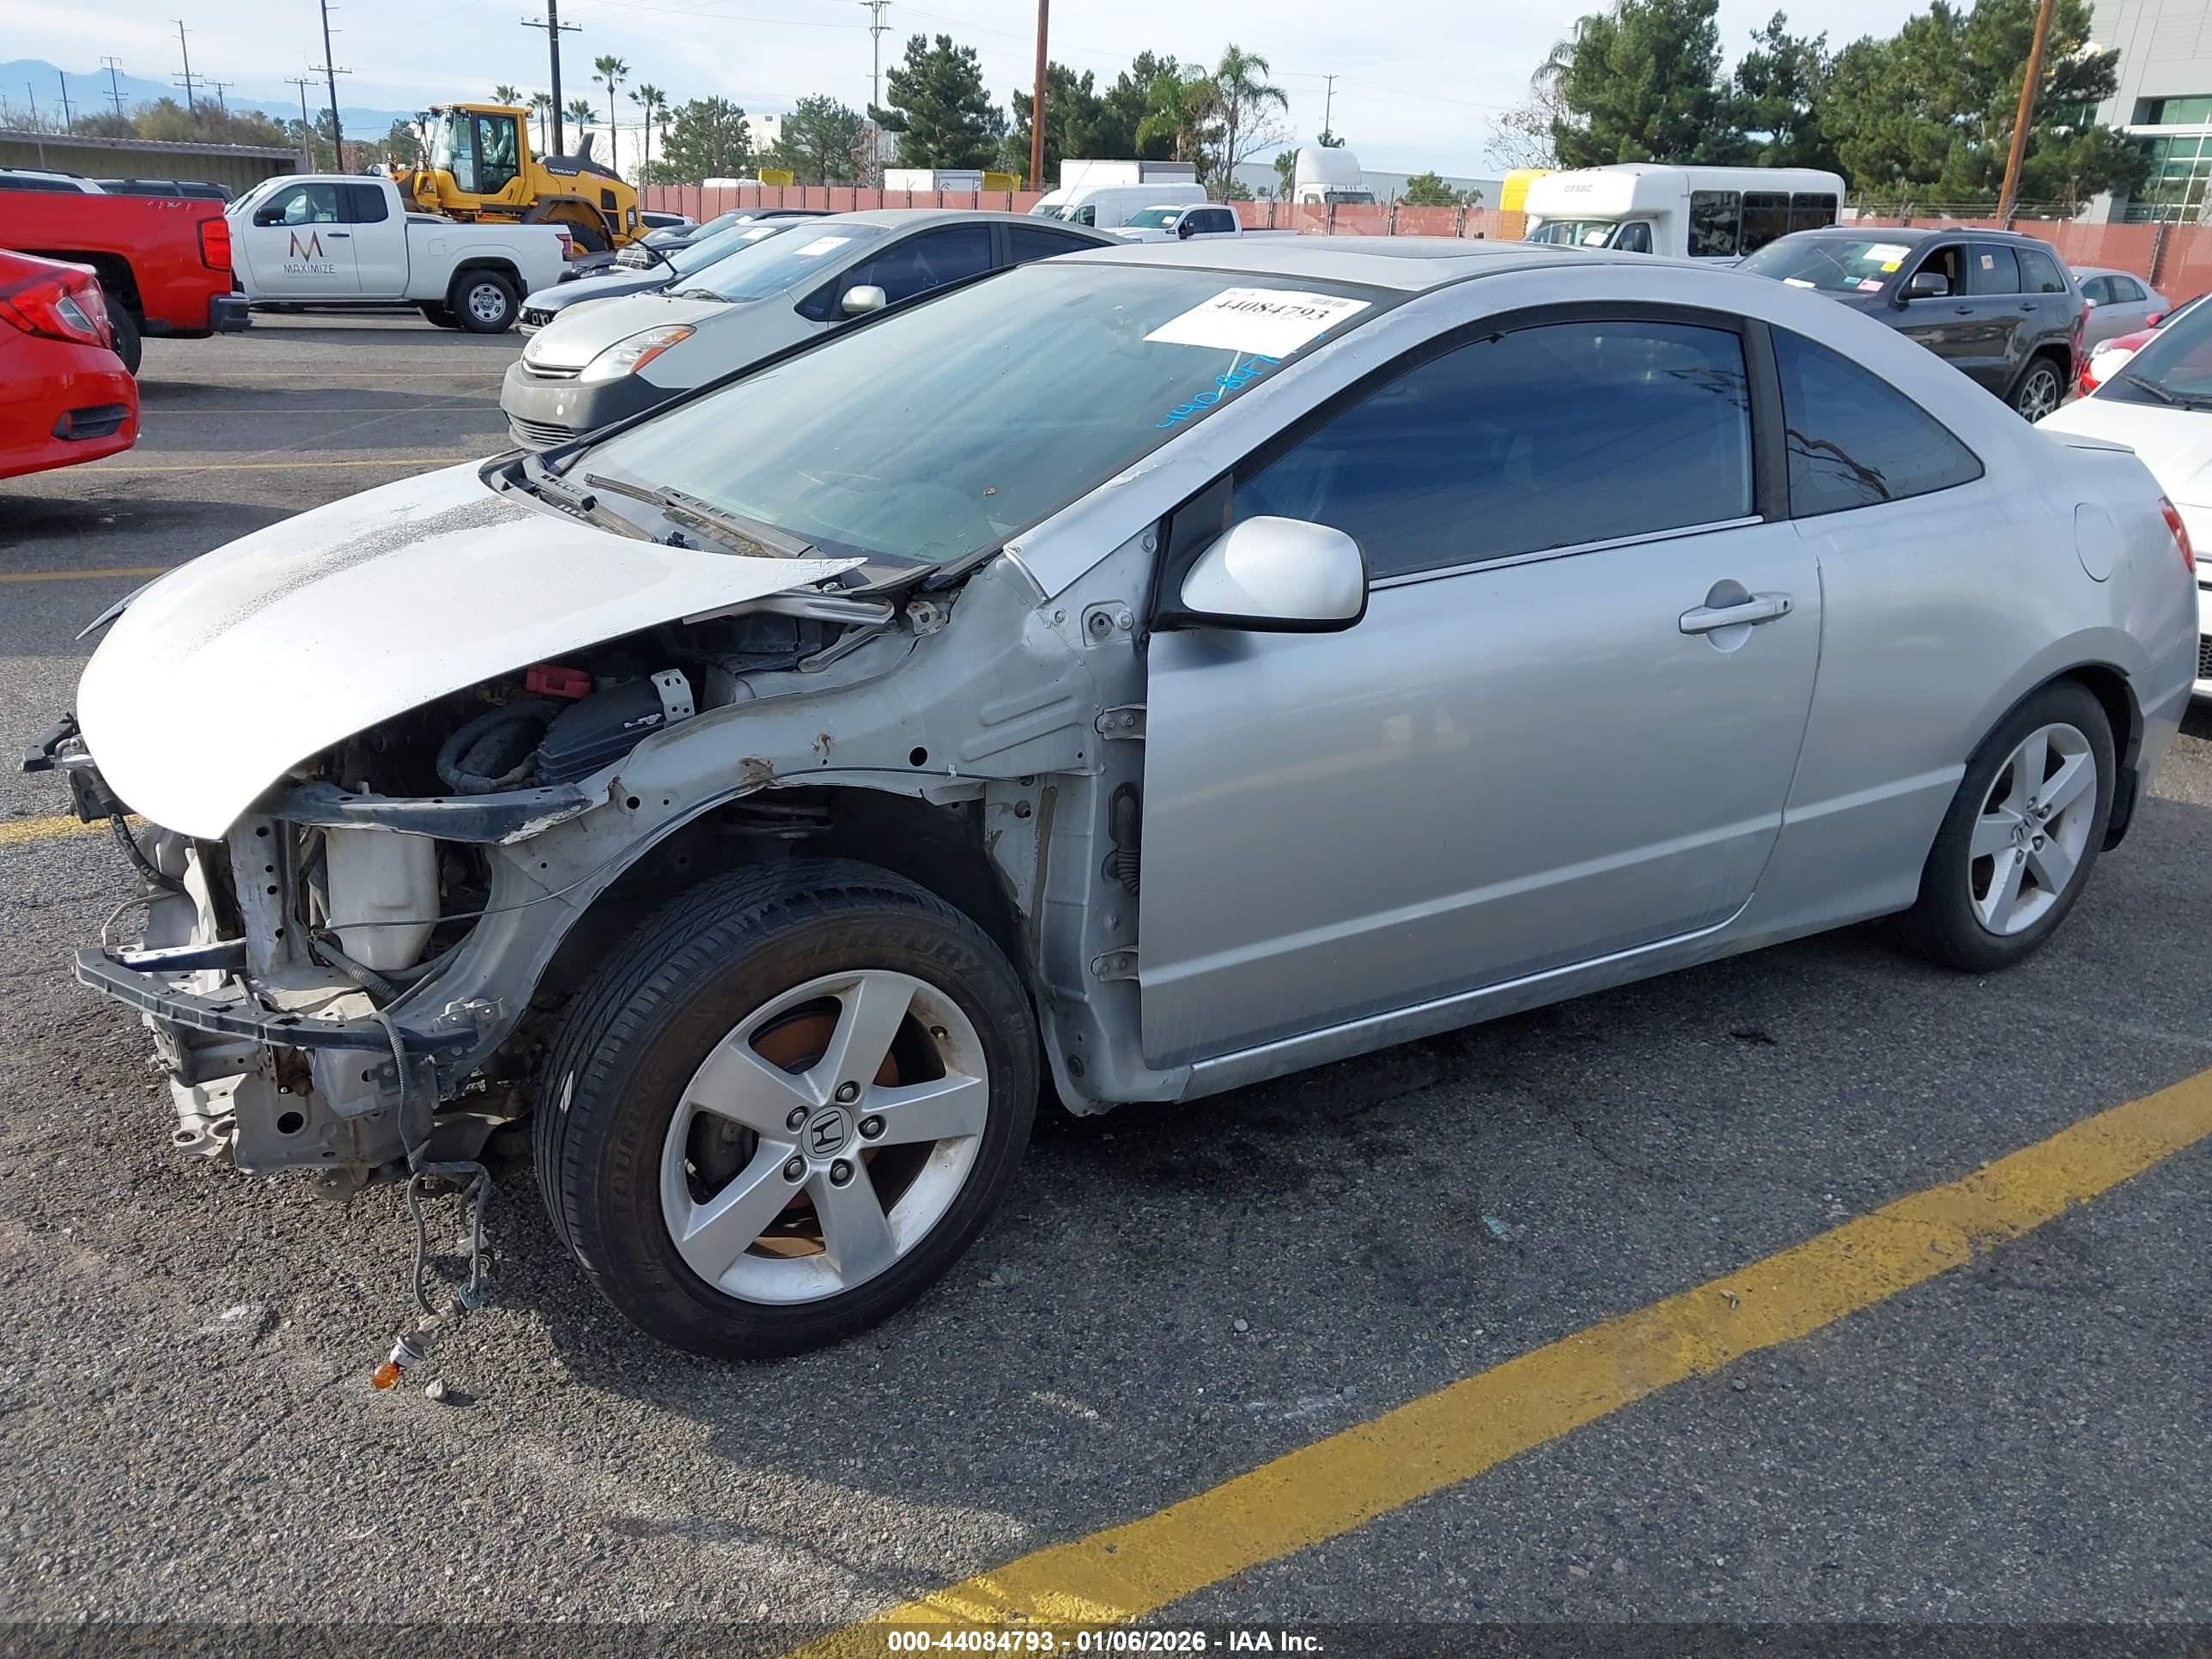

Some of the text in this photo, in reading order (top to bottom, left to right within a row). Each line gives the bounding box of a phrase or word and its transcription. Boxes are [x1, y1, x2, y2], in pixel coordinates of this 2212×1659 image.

[289, 229, 324, 263] M
[283, 264, 337, 274] MAXIMIZE
[1213, 299, 1330, 320] 44084793
